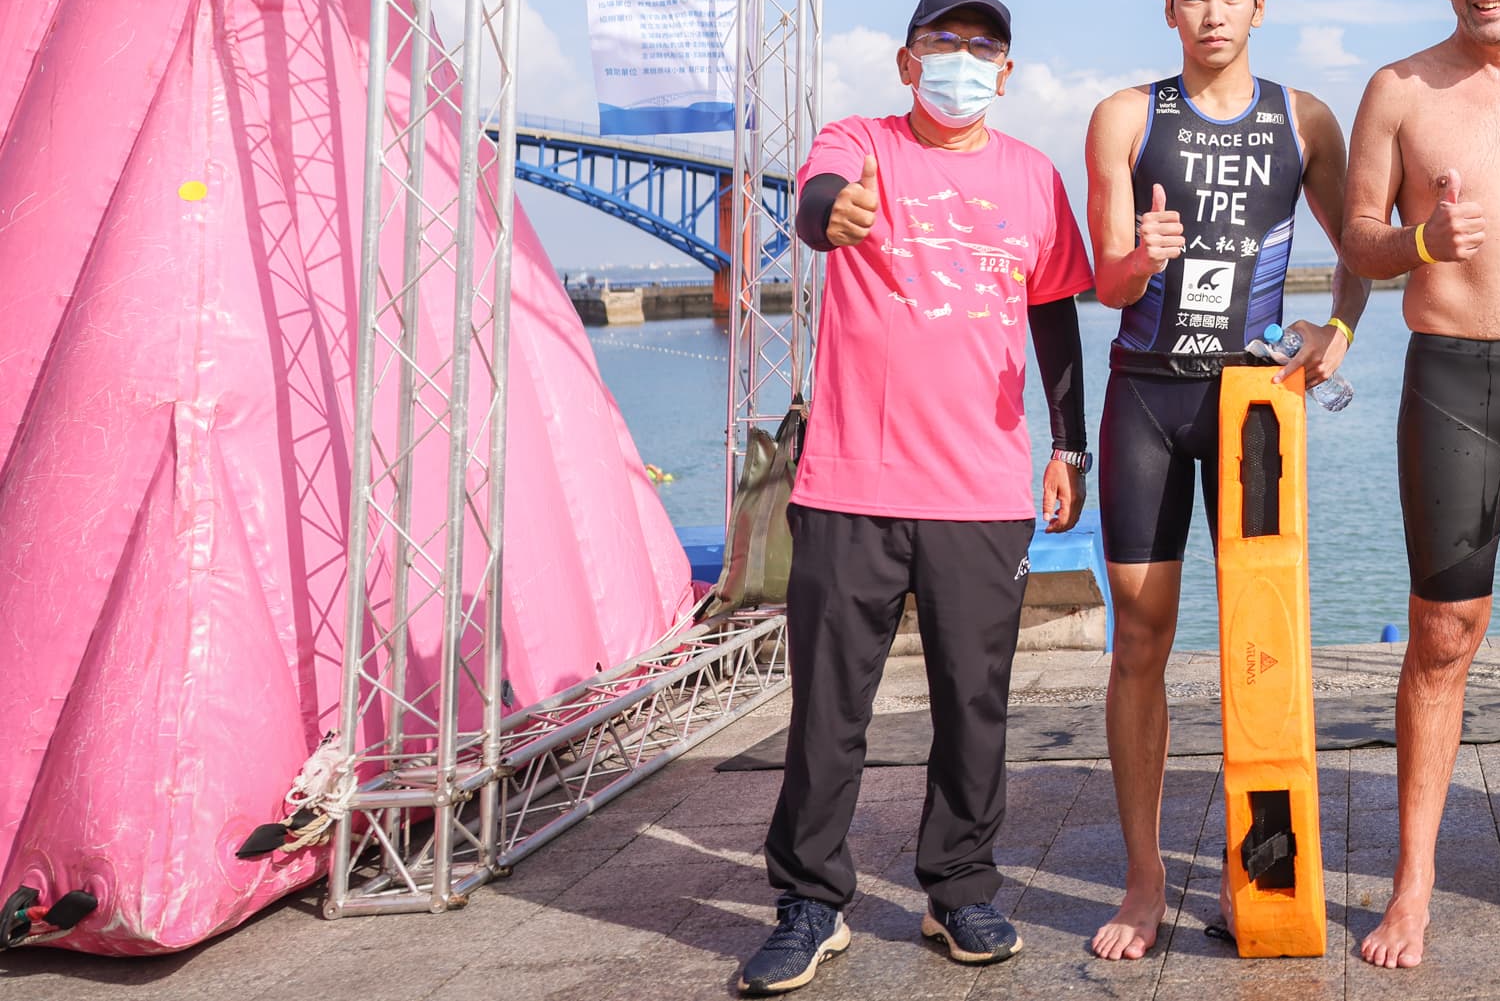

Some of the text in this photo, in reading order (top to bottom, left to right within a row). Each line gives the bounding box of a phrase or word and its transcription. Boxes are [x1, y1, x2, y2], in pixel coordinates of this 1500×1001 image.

[1196, 132, 1274, 147] RACE ON
[1179, 150, 1272, 186] TIEN
[1196, 188, 1248, 226] TPE
[1180, 234, 1260, 258] 人私塾
[1186, 291, 1223, 304] adhoc
[1175, 312, 1230, 330] 艾德國際
[1171, 333, 1224, 354] LAVA
